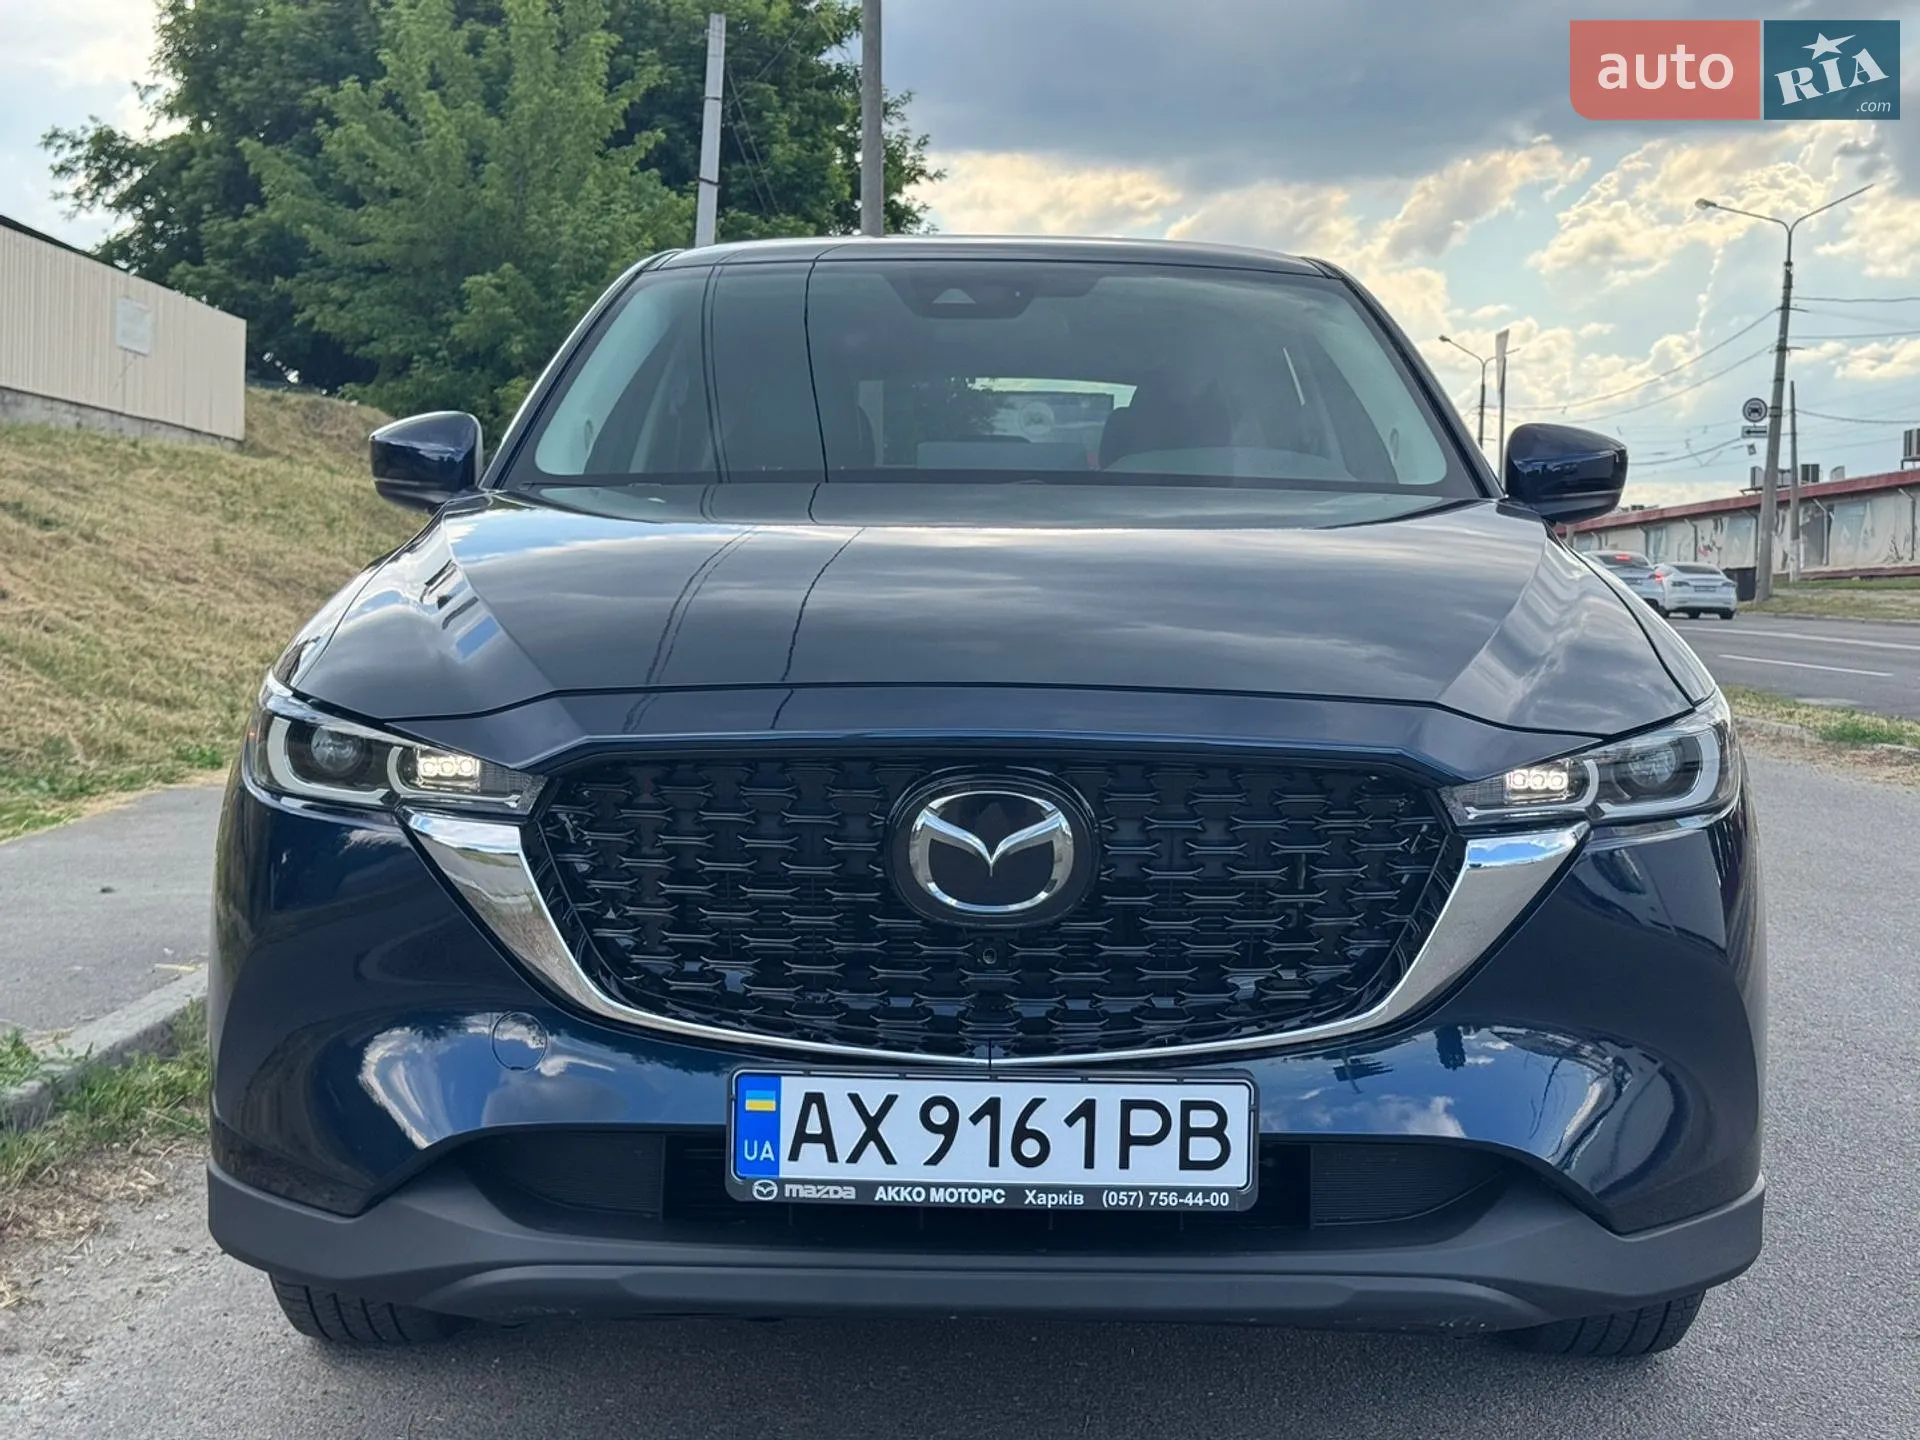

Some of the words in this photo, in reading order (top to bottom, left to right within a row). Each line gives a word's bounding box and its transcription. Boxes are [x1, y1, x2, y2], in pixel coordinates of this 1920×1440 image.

[788, 1091, 899, 1166] AX
[743, 1140, 776, 1162] UA
[874, 1185, 926, 1204] АККО
[929, 1188, 1006, 1205] МОТОРС
[1023, 1189, 1085, 1209] Харків
[1102, 1190, 1144, 1208] (057)
[1149, 1191, 1230, 1208] 756-44-00
